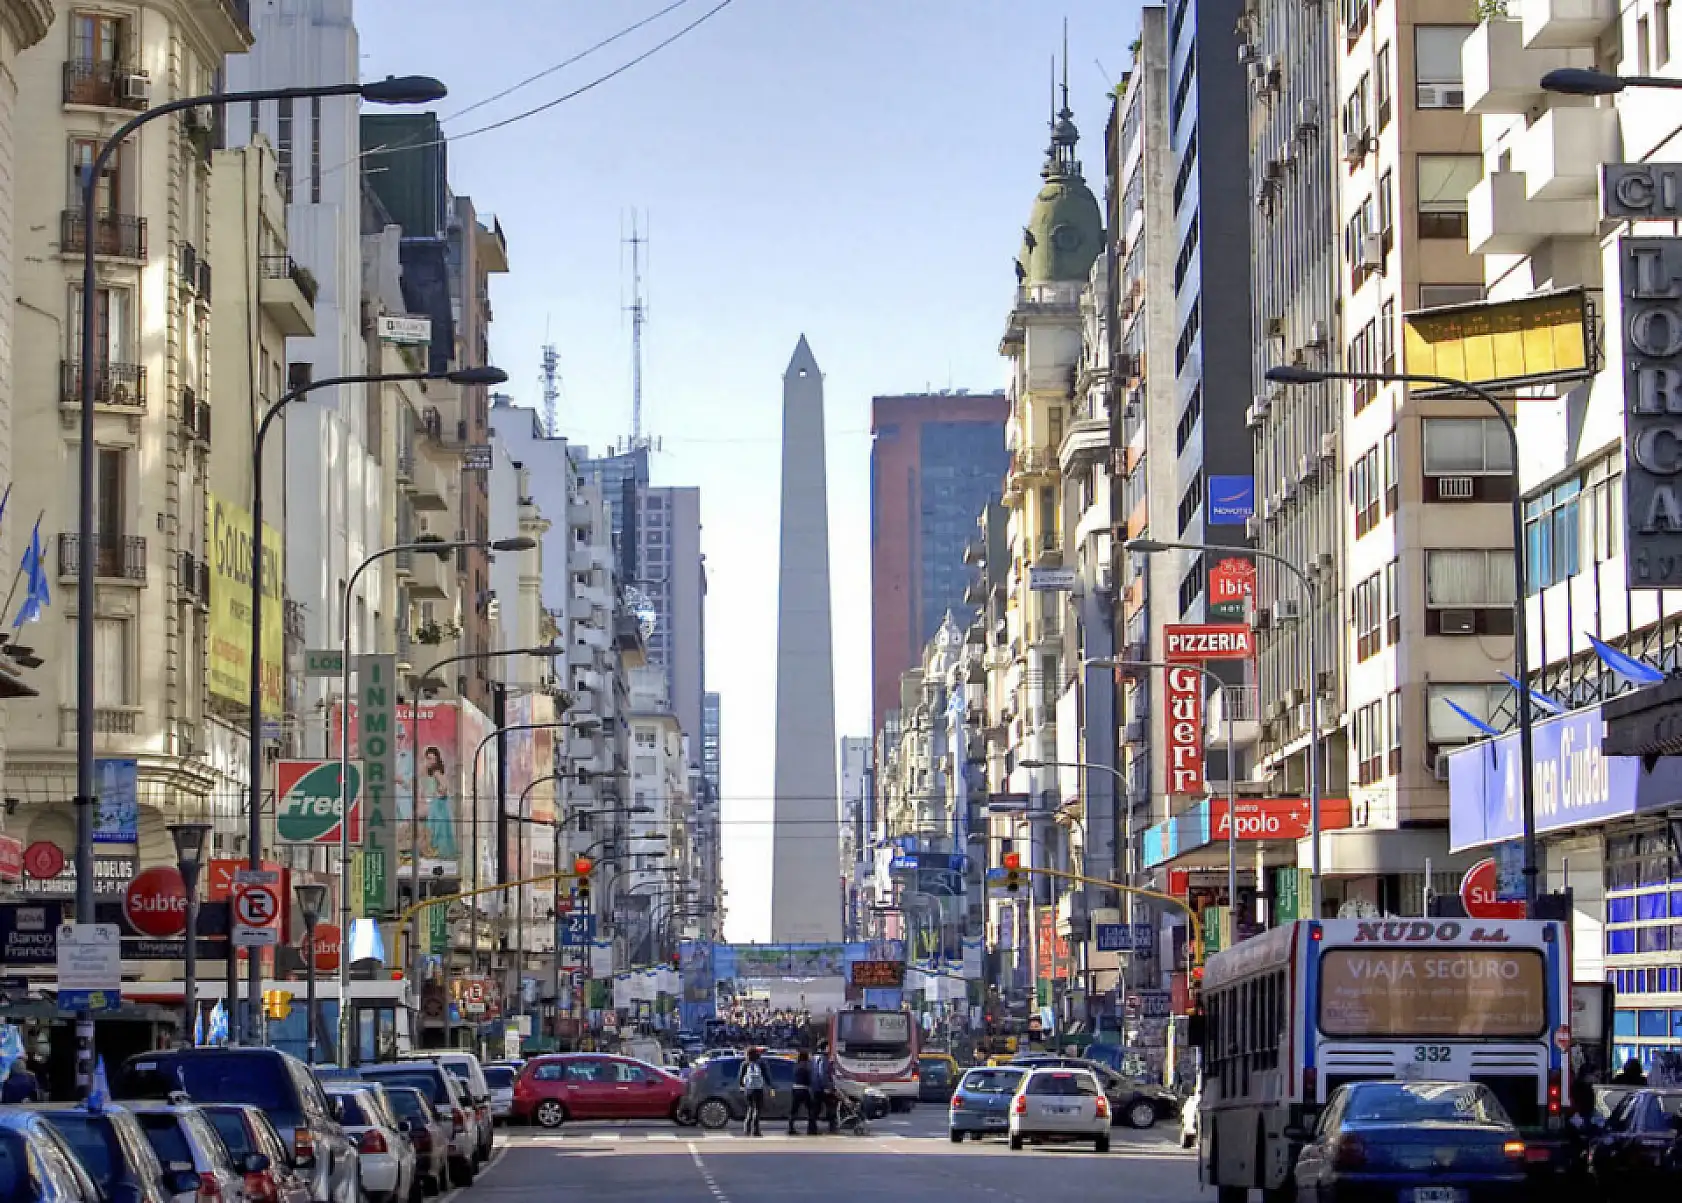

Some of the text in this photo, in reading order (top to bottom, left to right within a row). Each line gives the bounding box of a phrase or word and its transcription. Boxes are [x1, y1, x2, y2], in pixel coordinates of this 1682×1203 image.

[1630, 247, 1682, 534] LORCA
[1219, 578, 1252, 596] ibis
[1168, 633, 1248, 652] PIZZERIA
[309, 657, 342, 671] LOS
[1560, 720, 1609, 810] Ciudad
[1218, 811, 1280, 838] Apolo
[131, 893, 189, 912] Subte
[8, 932, 53, 947] Banco
[1354, 922, 1462, 942] NUDO
[1424, 960, 1520, 979] SEGURO
[1414, 1046, 1452, 1062] 332
